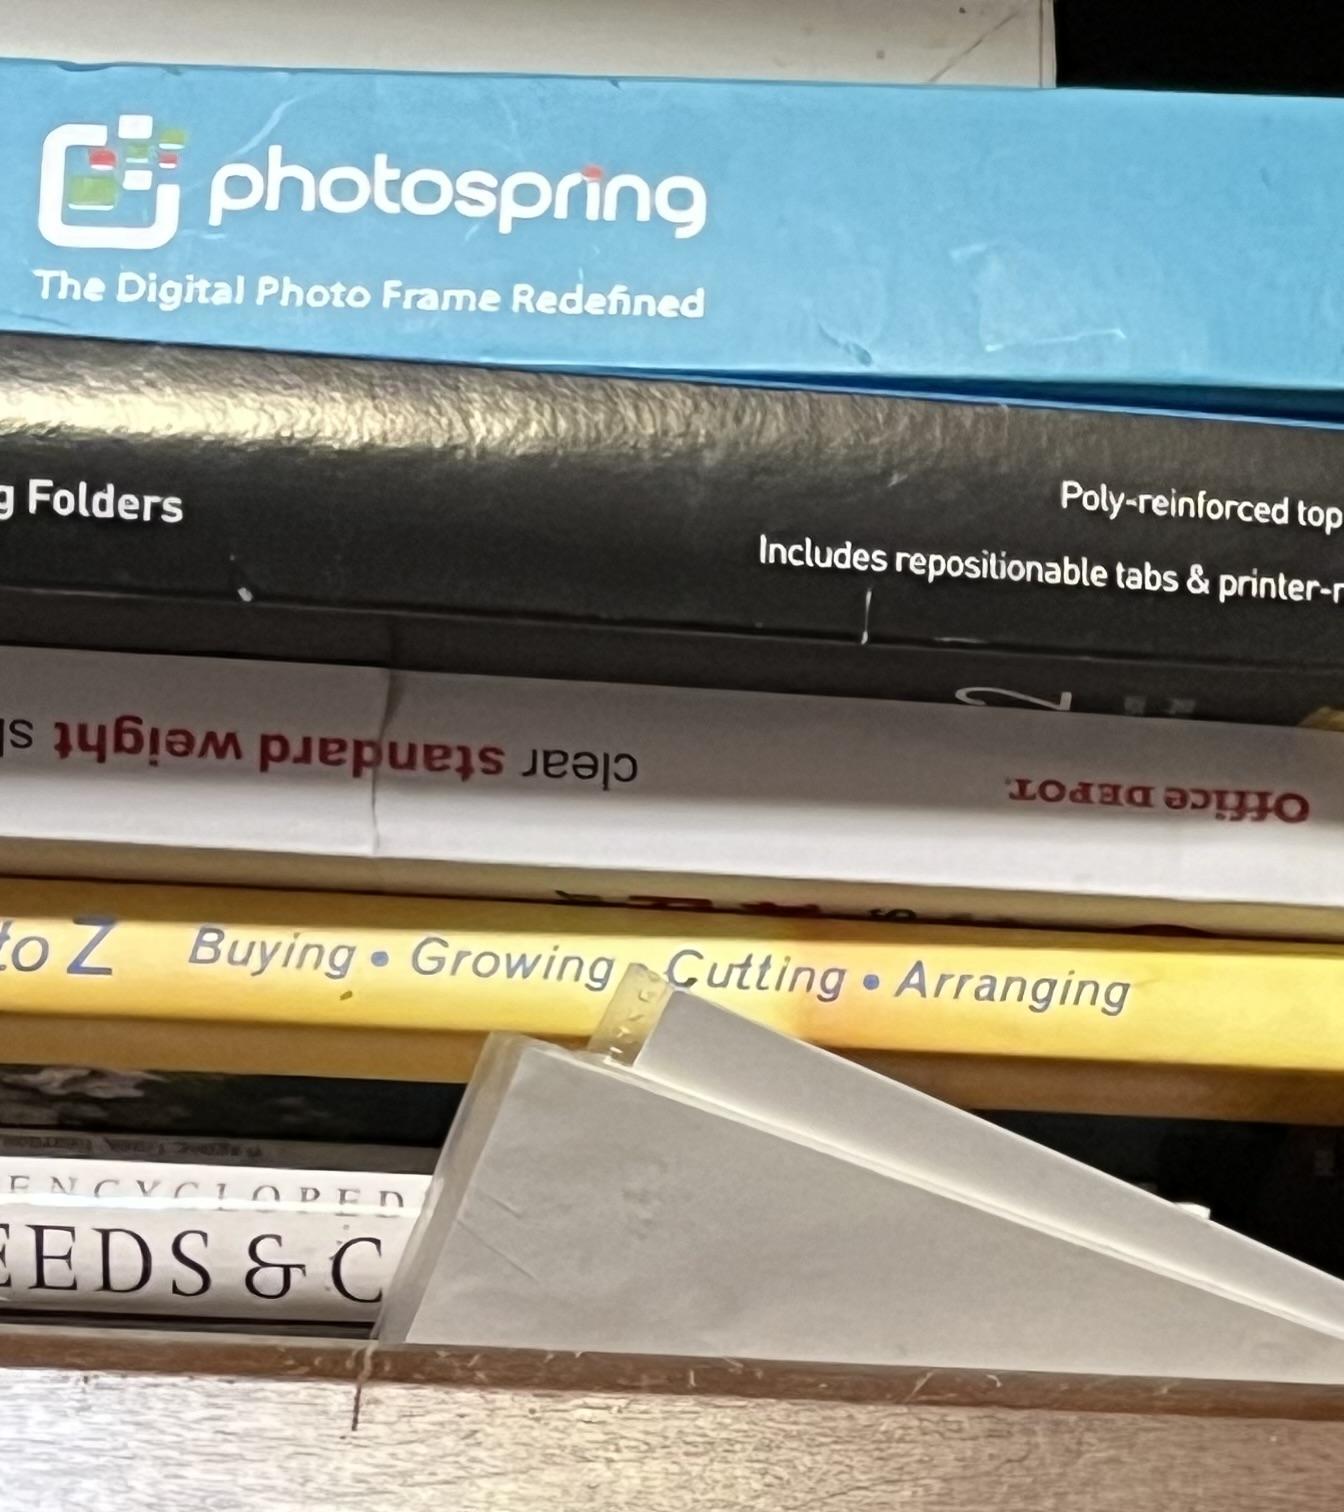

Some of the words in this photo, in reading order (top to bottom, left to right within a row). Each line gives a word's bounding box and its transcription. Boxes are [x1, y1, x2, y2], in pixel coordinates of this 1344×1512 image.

[209, 144, 706, 238] photospring
[34, 269, 105, 304] The
[116, 271, 245, 312] Digital
[256, 275, 371, 310] Photo
[382, 280, 500, 314] Frame
[512, 284, 705, 320] Redefined
[28, 478, 184, 523] Folders
[1060, 480, 1290, 527] Poly-reinforced
[1298, 499, 1343, 535] top
[758, 535, 888, 574] Includes
[895, 547, 1109, 591] repositionable
[1115, 560, 1179, 594] tabs
[1185, 566, 1211, 595] &
[54, 715, 244, 767] weight
[259, 731, 506, 782] standard
[521, 744, 639, 790] clear
[1164, 783, 1310, 823] Office
[0, 920, 50, 973] to
[66, 914, 117, 976] Z
[188, 926, 357, 981] Buying
[410, 935, 616, 993] Growing
[665, 948, 847, 1003] Cutting
[894, 960, 1132, 1017] Arranging
[0, 1222, 212, 1299] EDS
[245, 1233, 307, 1300] &
